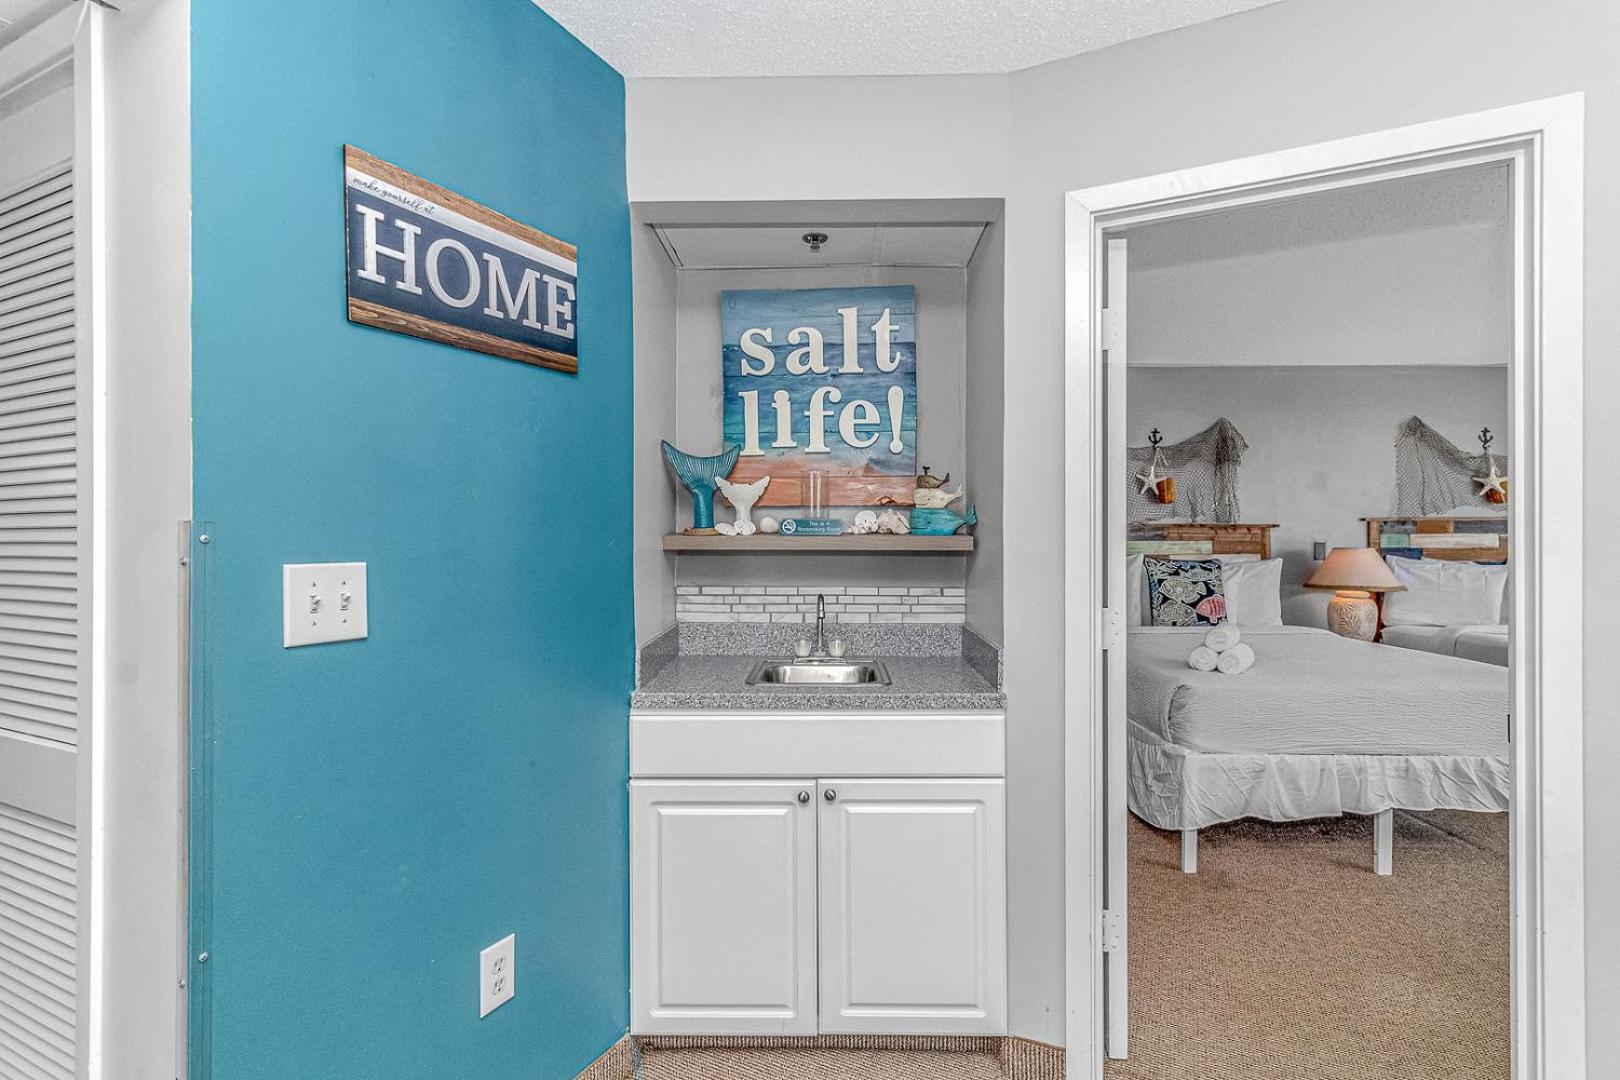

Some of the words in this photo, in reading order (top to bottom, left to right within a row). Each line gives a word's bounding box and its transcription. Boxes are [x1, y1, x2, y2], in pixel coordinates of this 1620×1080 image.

[353, 178, 381, 192] make
[382, 190, 424, 212] yourself
[425, 205, 435, 215] at
[356, 204, 576, 340] HOME
[740, 307, 901, 376] salt
[738, 386, 904, 457] life!
